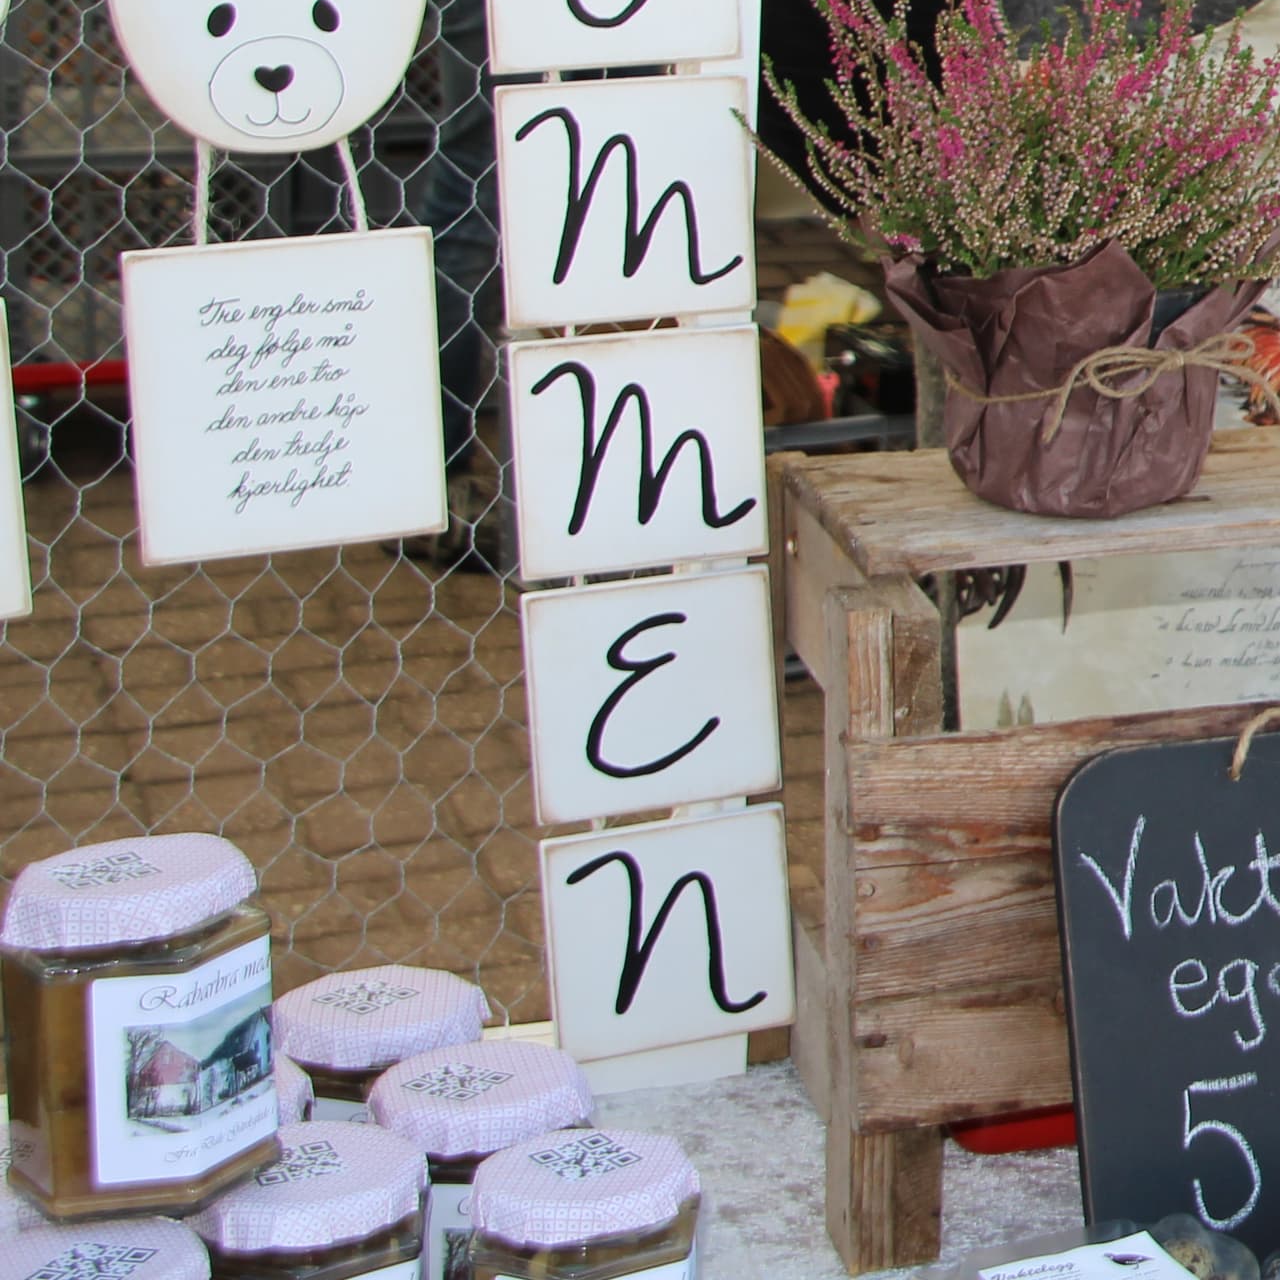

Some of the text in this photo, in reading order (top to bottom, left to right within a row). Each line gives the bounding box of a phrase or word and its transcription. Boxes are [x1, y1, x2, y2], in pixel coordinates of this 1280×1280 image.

[199, 289, 374, 332] Tre engler små
[206, 323, 357, 376] deg følge må
[216, 358, 350, 397] den ene tro
[204, 393, 370, 433] den andre håp
[231, 430, 350, 466] den tredje
[139, 968, 239, 1011] Rabarbra
